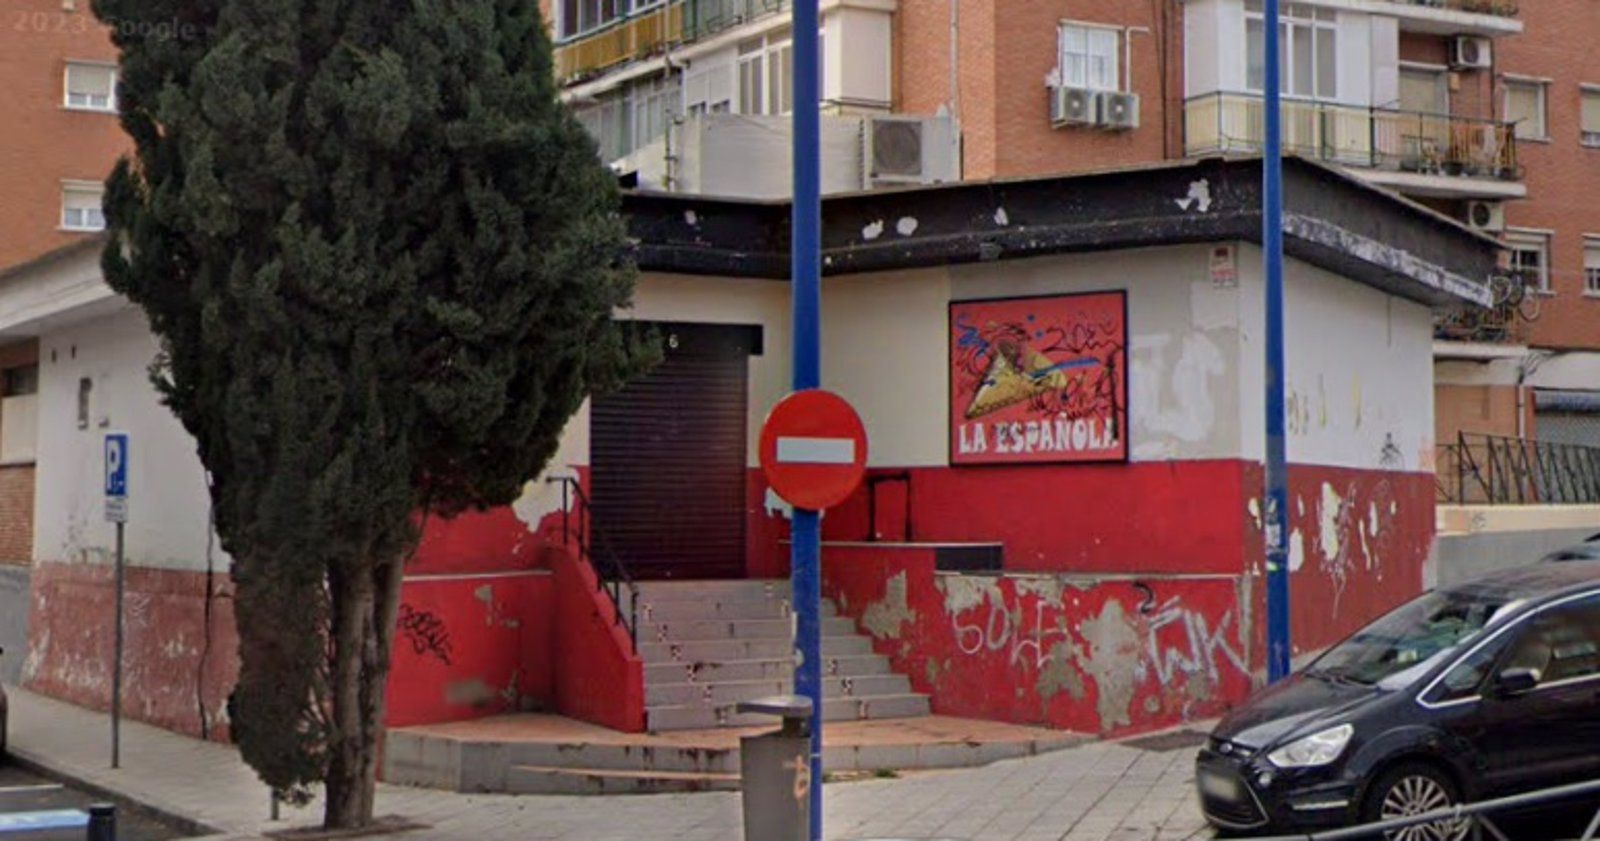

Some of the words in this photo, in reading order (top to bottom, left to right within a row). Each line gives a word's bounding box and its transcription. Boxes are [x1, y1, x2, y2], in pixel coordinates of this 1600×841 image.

[669, 334, 679, 348] 6
[959, 423, 987, 454] LA
[995, 412, 1119, 454] ESPAÑOLA
[106, 440, 121, 490] P
